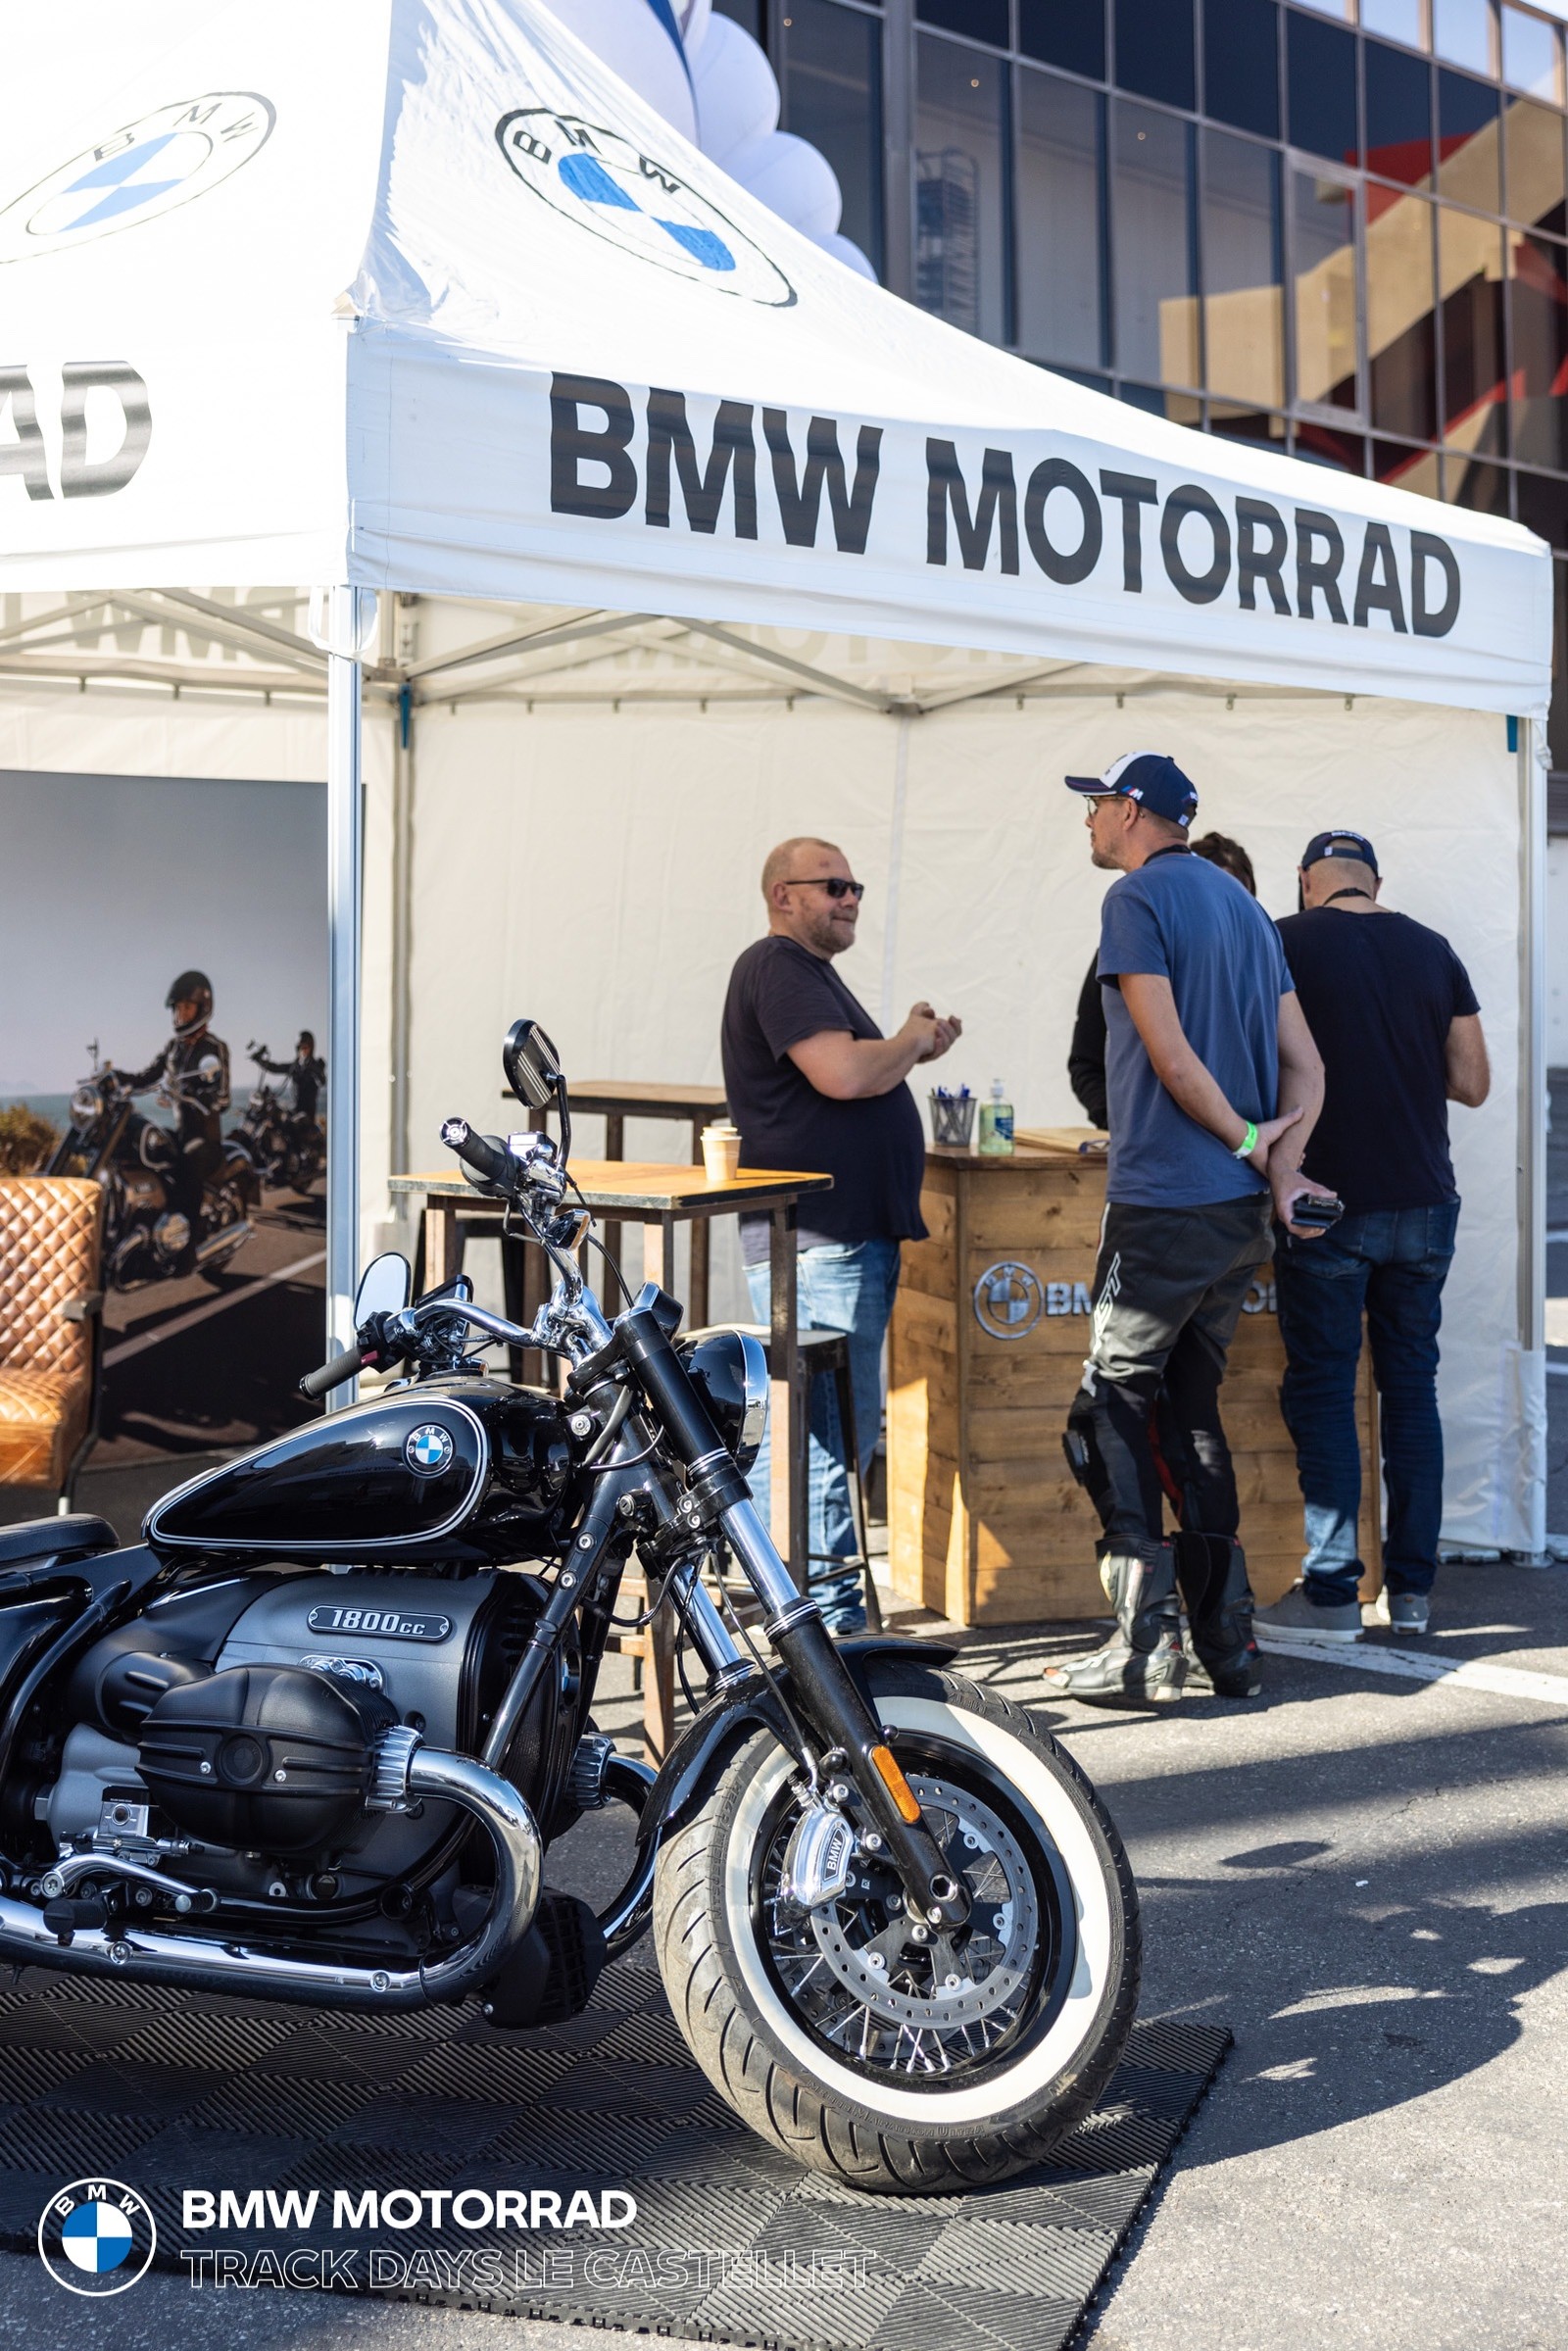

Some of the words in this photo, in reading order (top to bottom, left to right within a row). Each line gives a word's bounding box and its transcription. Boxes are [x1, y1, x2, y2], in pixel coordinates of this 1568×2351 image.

[94, 102, 260, 163] BMW
[513, 119, 681, 194] BMW
[550, 370, 884, 556] BMW
[925, 437, 1461, 639] MOTORRAD
[1046, 1282, 1093, 1315] BM
[413, 1427, 449, 1444] BMW
[331, 1609, 425, 1636] 1800cc
[826, 1837, 843, 1871] BMW
